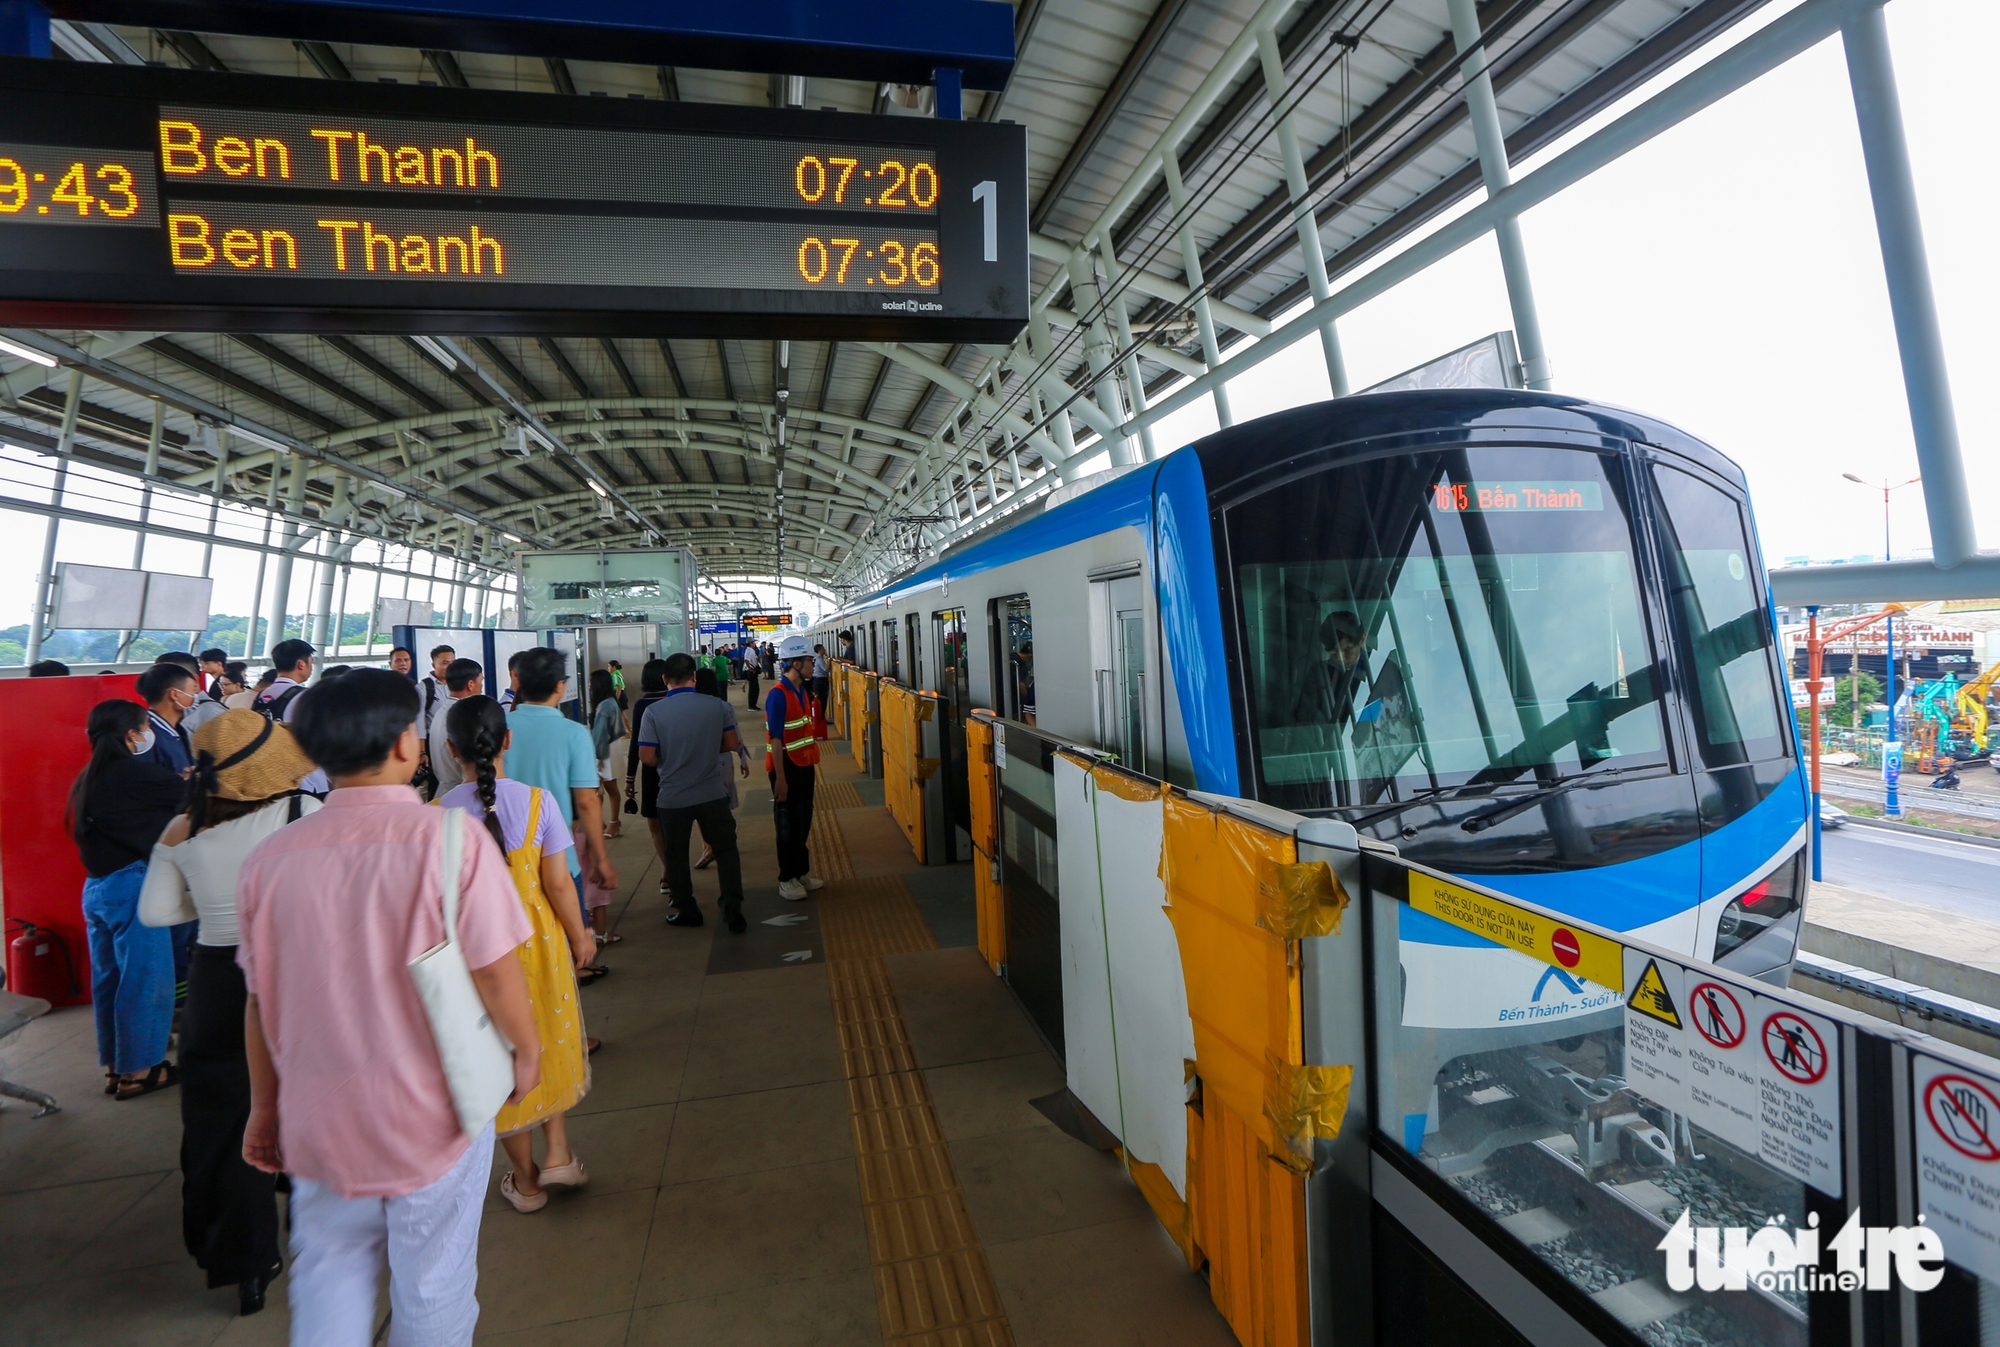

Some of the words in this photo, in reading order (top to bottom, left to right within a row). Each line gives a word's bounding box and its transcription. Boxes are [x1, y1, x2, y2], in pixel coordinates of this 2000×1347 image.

[158, 119, 291, 180] Ben
[311, 128, 499, 189] Thanh
[796, 155, 939, 208] 07:20
[972, 180, 998, 262] 1
[168, 213, 298, 270] Ben
[318, 219, 505, 275] Thanh
[798, 237, 940, 287] 07:36
[882, 301, 906, 311] solari
[919, 302, 943, 311] udine
[1478, 484, 1517, 508] Bến
[1522, 489, 1582, 508] Thành
[1919, 629, 1974, 642] THÀNH
[1434, 889, 1459, 907] KHÔNG
[1461, 897, 1472, 911] SỬ
[1474, 903, 1496, 921] DỤNG
[1498, 911, 1516, 928] CỬA
[1434, 900, 1451, 916] THIS
[1453, 908, 1474, 925] DOOR
[1476, 917, 1484, 929] IS
[1487, 921, 1503, 935] NOT
[1506, 928, 1515, 941] IN
[1517, 934, 1535, 949] USE
[1498, 1006, 1525, 1021] Bến
[1528, 1001, 1568, 1018] Thành
[1580, 992, 1609, 1010] Suối
[1630, 1018, 1653, 1036] Không
[1630, 1028, 1649, 1043] Ngón
[1651, 1037, 1665, 1051] Tay
[1667, 1046, 1682, 1058] vào
[1630, 1038, 1644, 1051] Khe
[1689, 1048, 1715, 1069] Không
[1718, 1060, 1735, 1076] Tựa
[1737, 1071, 1754, 1085] vào
[1692, 1060, 1709, 1076] Cửa
[1691, 1085, 1700, 1094] Do
[1702, 1090, 1712, 1101] Not
[1760, 1077, 1791, 1100] Không
[1793, 1091, 1814, 1109] Thò
[1761, 1088, 1780, 1106] Đầu
[1784, 1100, 1808, 1119] hoặc
[1811, 1112, 1833, 1131] Đưa
[1762, 1100, 1779, 1118] Tay
[1782, 1111, 1802, 1128] Qua
[1806, 1121, 1828, 1141] Phía
[1761, 1112, 1788, 1133] Ngoài
[1791, 1127, 1812, 1145] Cửa
[1762, 1130, 1771, 1140] Do
[1773, 1135, 1785, 1147] Not
[1787, 1143, 1812, 1161] Stretch
[1815, 1156, 1829, 1170] Out
[1762, 1138, 1779, 1152] Head
[1791, 1152, 1810, 1168] Hand
[1789, 1160, 1810, 1176] Doors
[1922, 1154, 1965, 1185] Không
